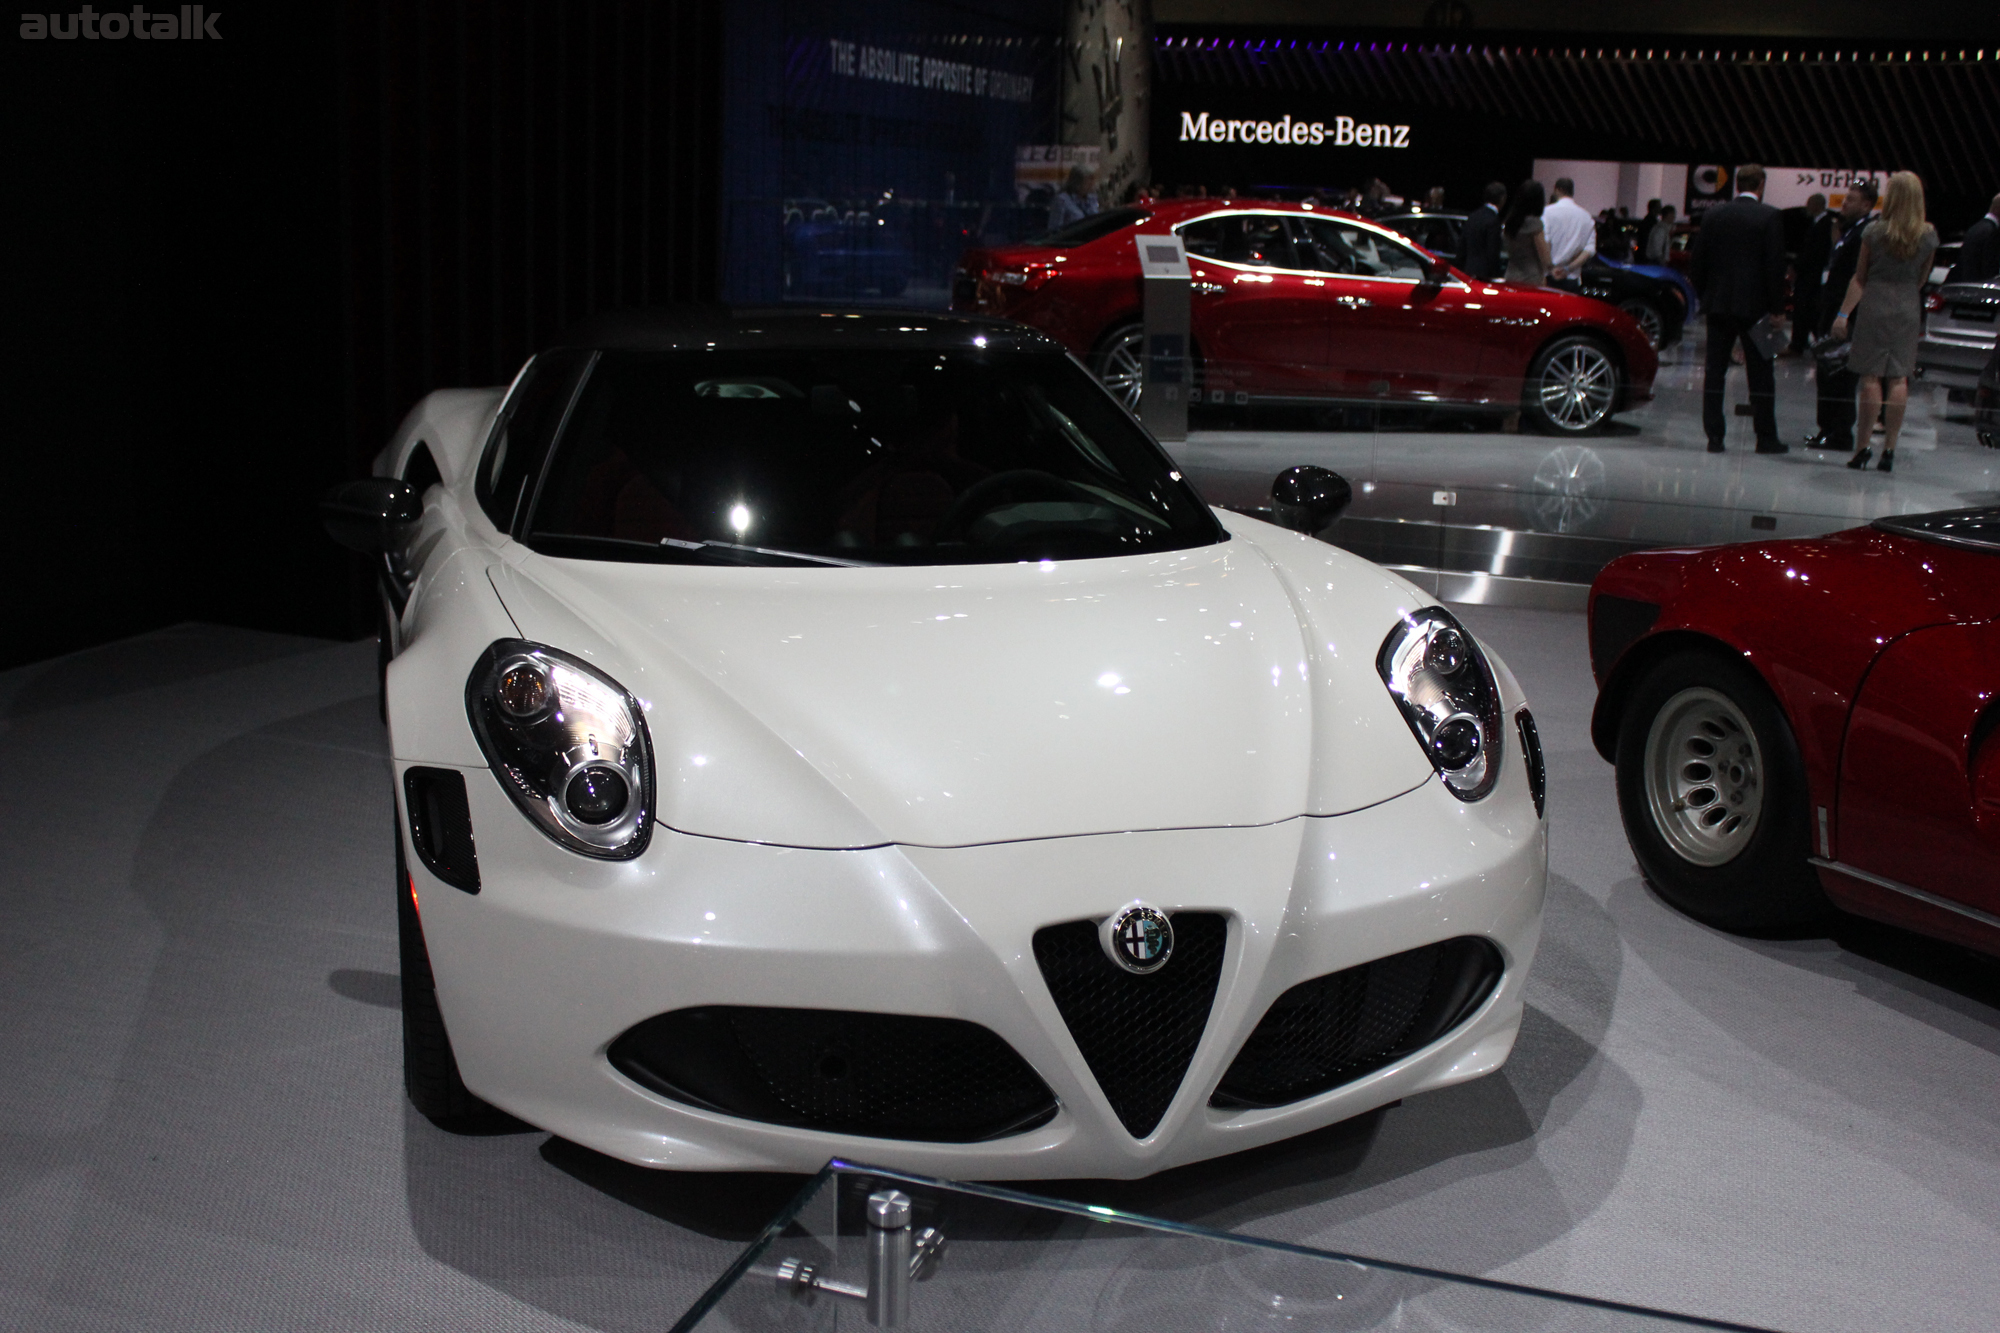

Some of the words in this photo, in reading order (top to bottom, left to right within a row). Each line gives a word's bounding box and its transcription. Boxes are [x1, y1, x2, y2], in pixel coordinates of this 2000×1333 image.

[829, 38, 856, 76] THE
[858, 45, 920, 87] ABSOLUTE
[922, 57, 973, 95] OPPOSITE
[974, 67, 989, 97] OF
[1179, 111, 1410, 148] Mercedes-Benz
